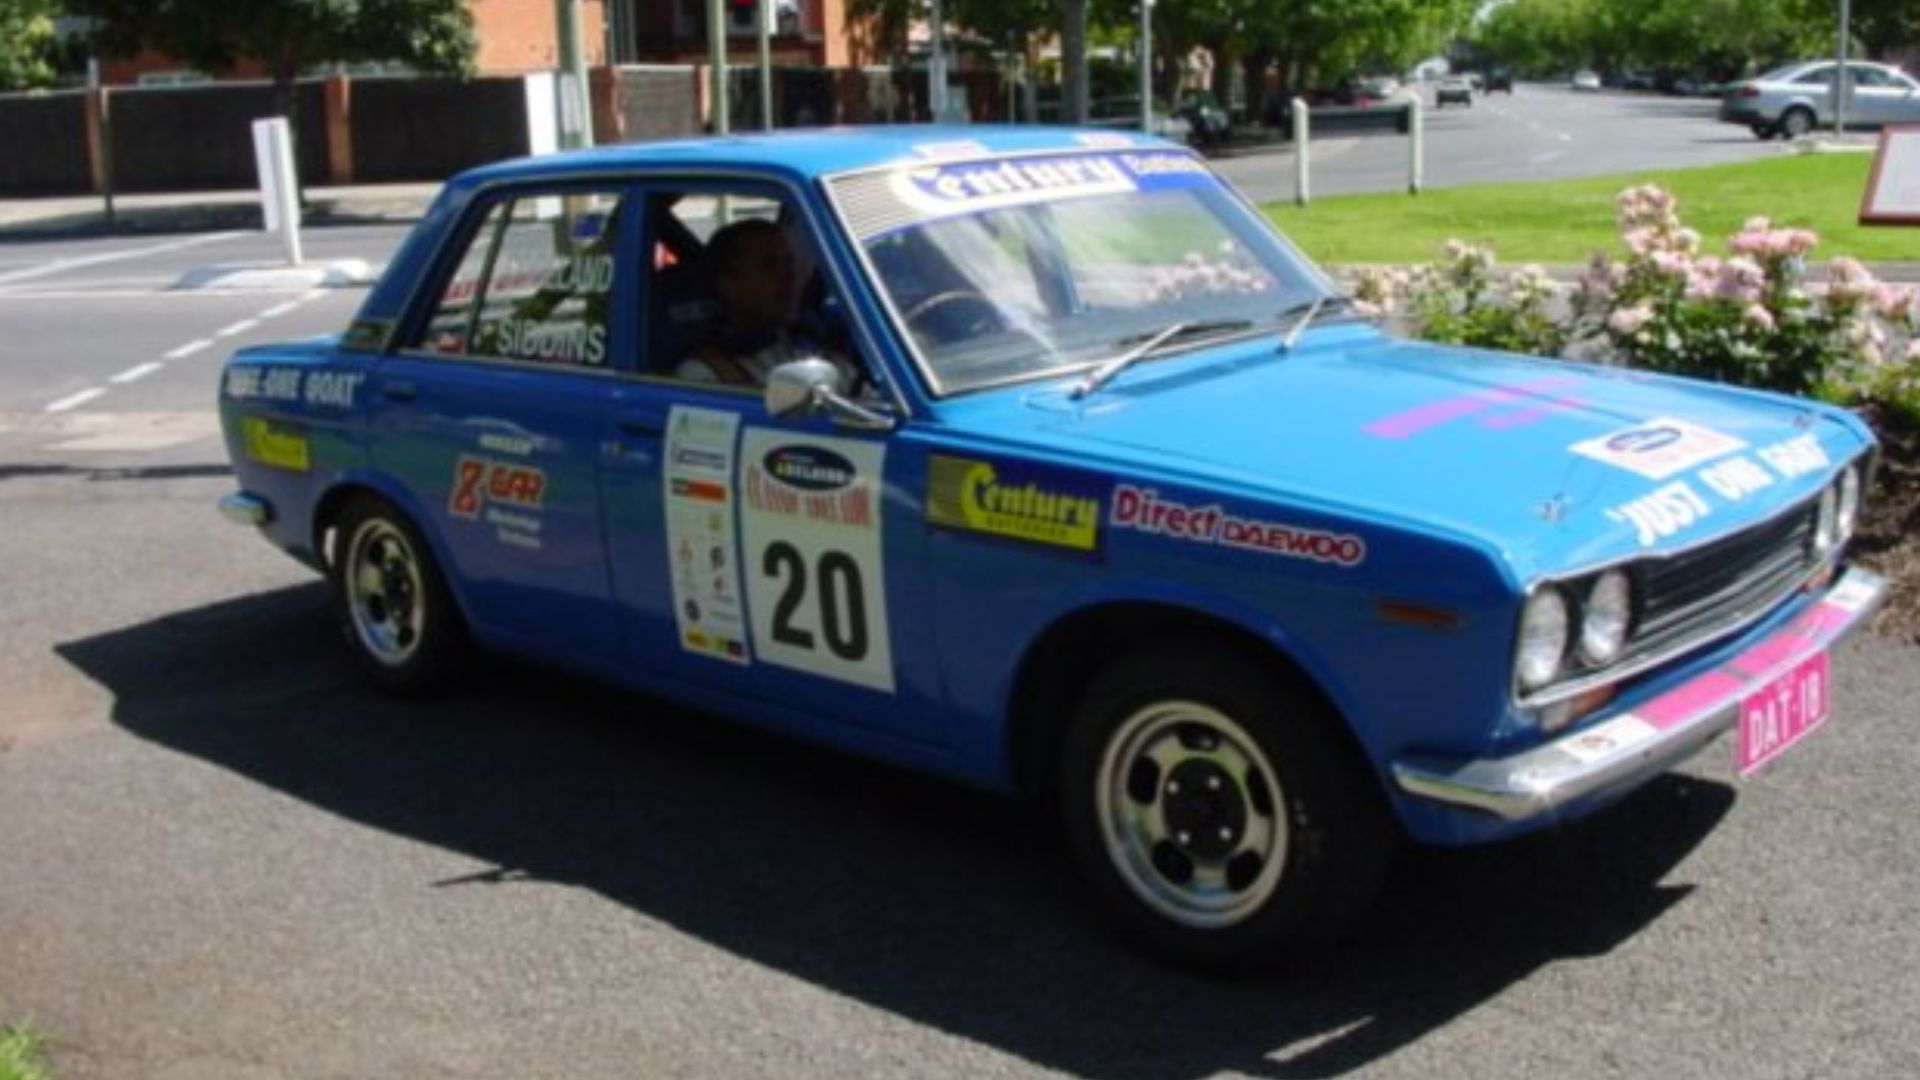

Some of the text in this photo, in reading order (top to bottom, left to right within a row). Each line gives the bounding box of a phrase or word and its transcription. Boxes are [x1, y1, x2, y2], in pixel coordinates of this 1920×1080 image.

[890, 150, 1137, 212] Century
[961, 460, 1099, 527] Century
[1112, 486, 1366, 566] Direct DAEWOO
[761, 539, 871, 663] 20
